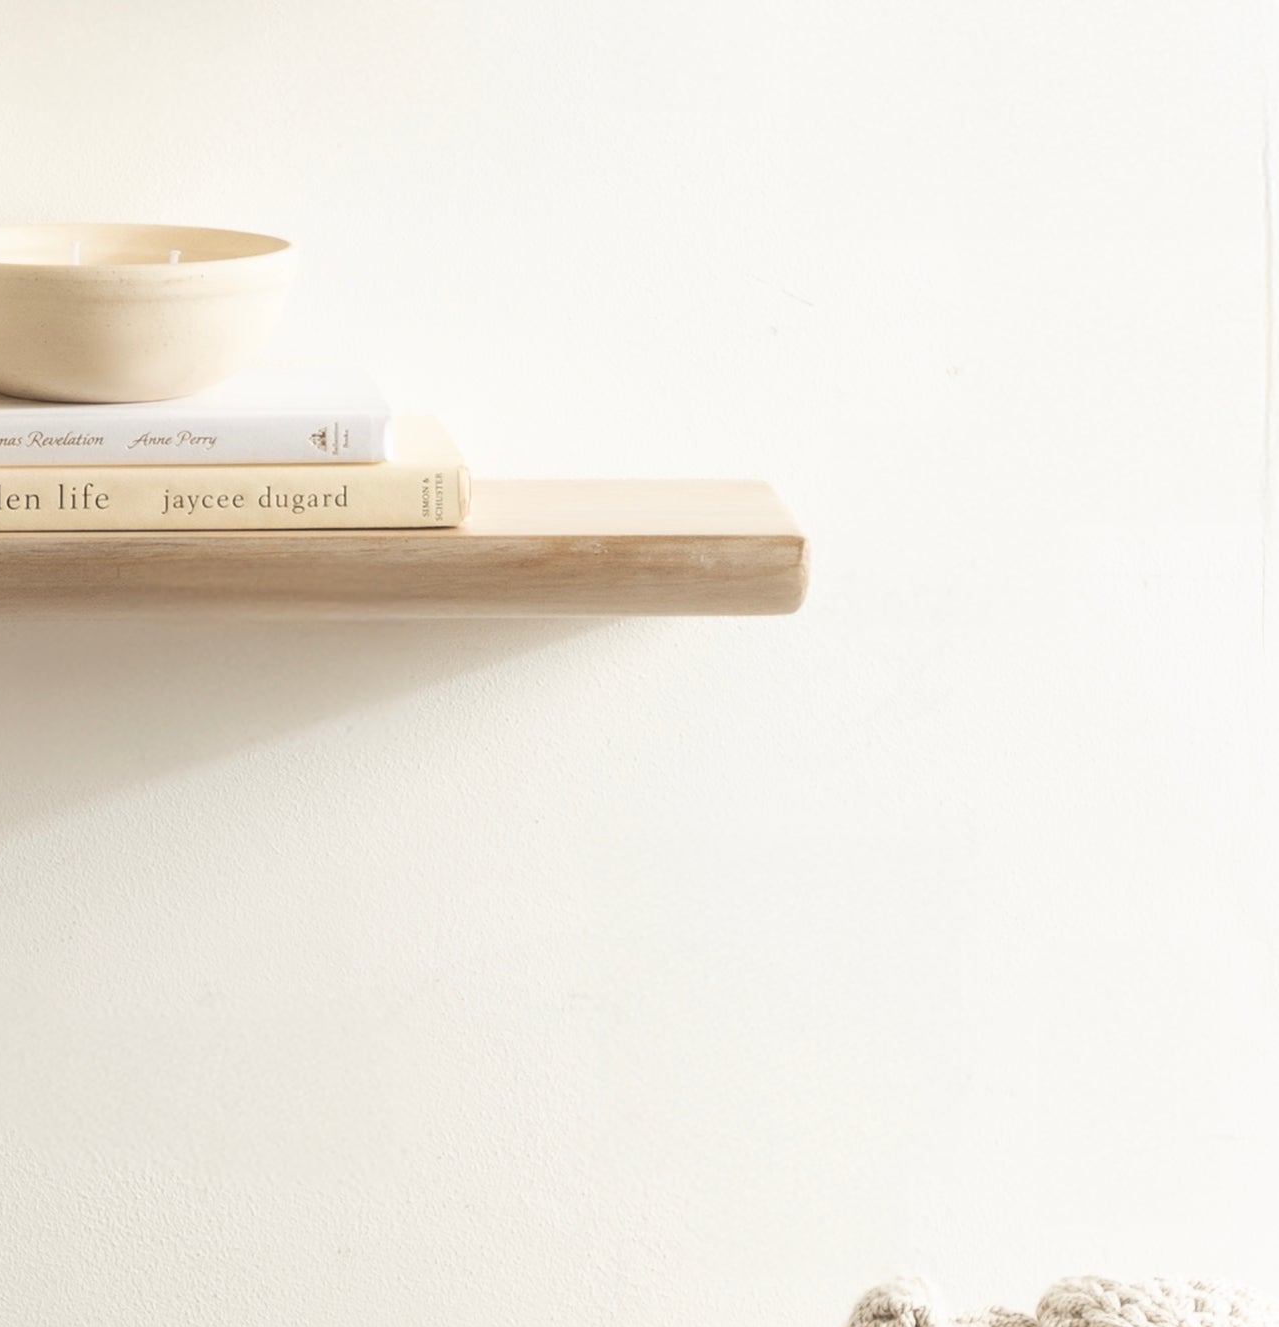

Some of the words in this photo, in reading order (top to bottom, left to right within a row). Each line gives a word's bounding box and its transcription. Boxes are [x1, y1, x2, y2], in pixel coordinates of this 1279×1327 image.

[25, 431, 104, 448] Revelation
[127, 432, 173, 450] Anne
[176, 431, 218, 450] Perry
[58, 483, 110, 510] life
[161, 489, 246, 515] jaycee
[258, 485, 348, 514] dugard
